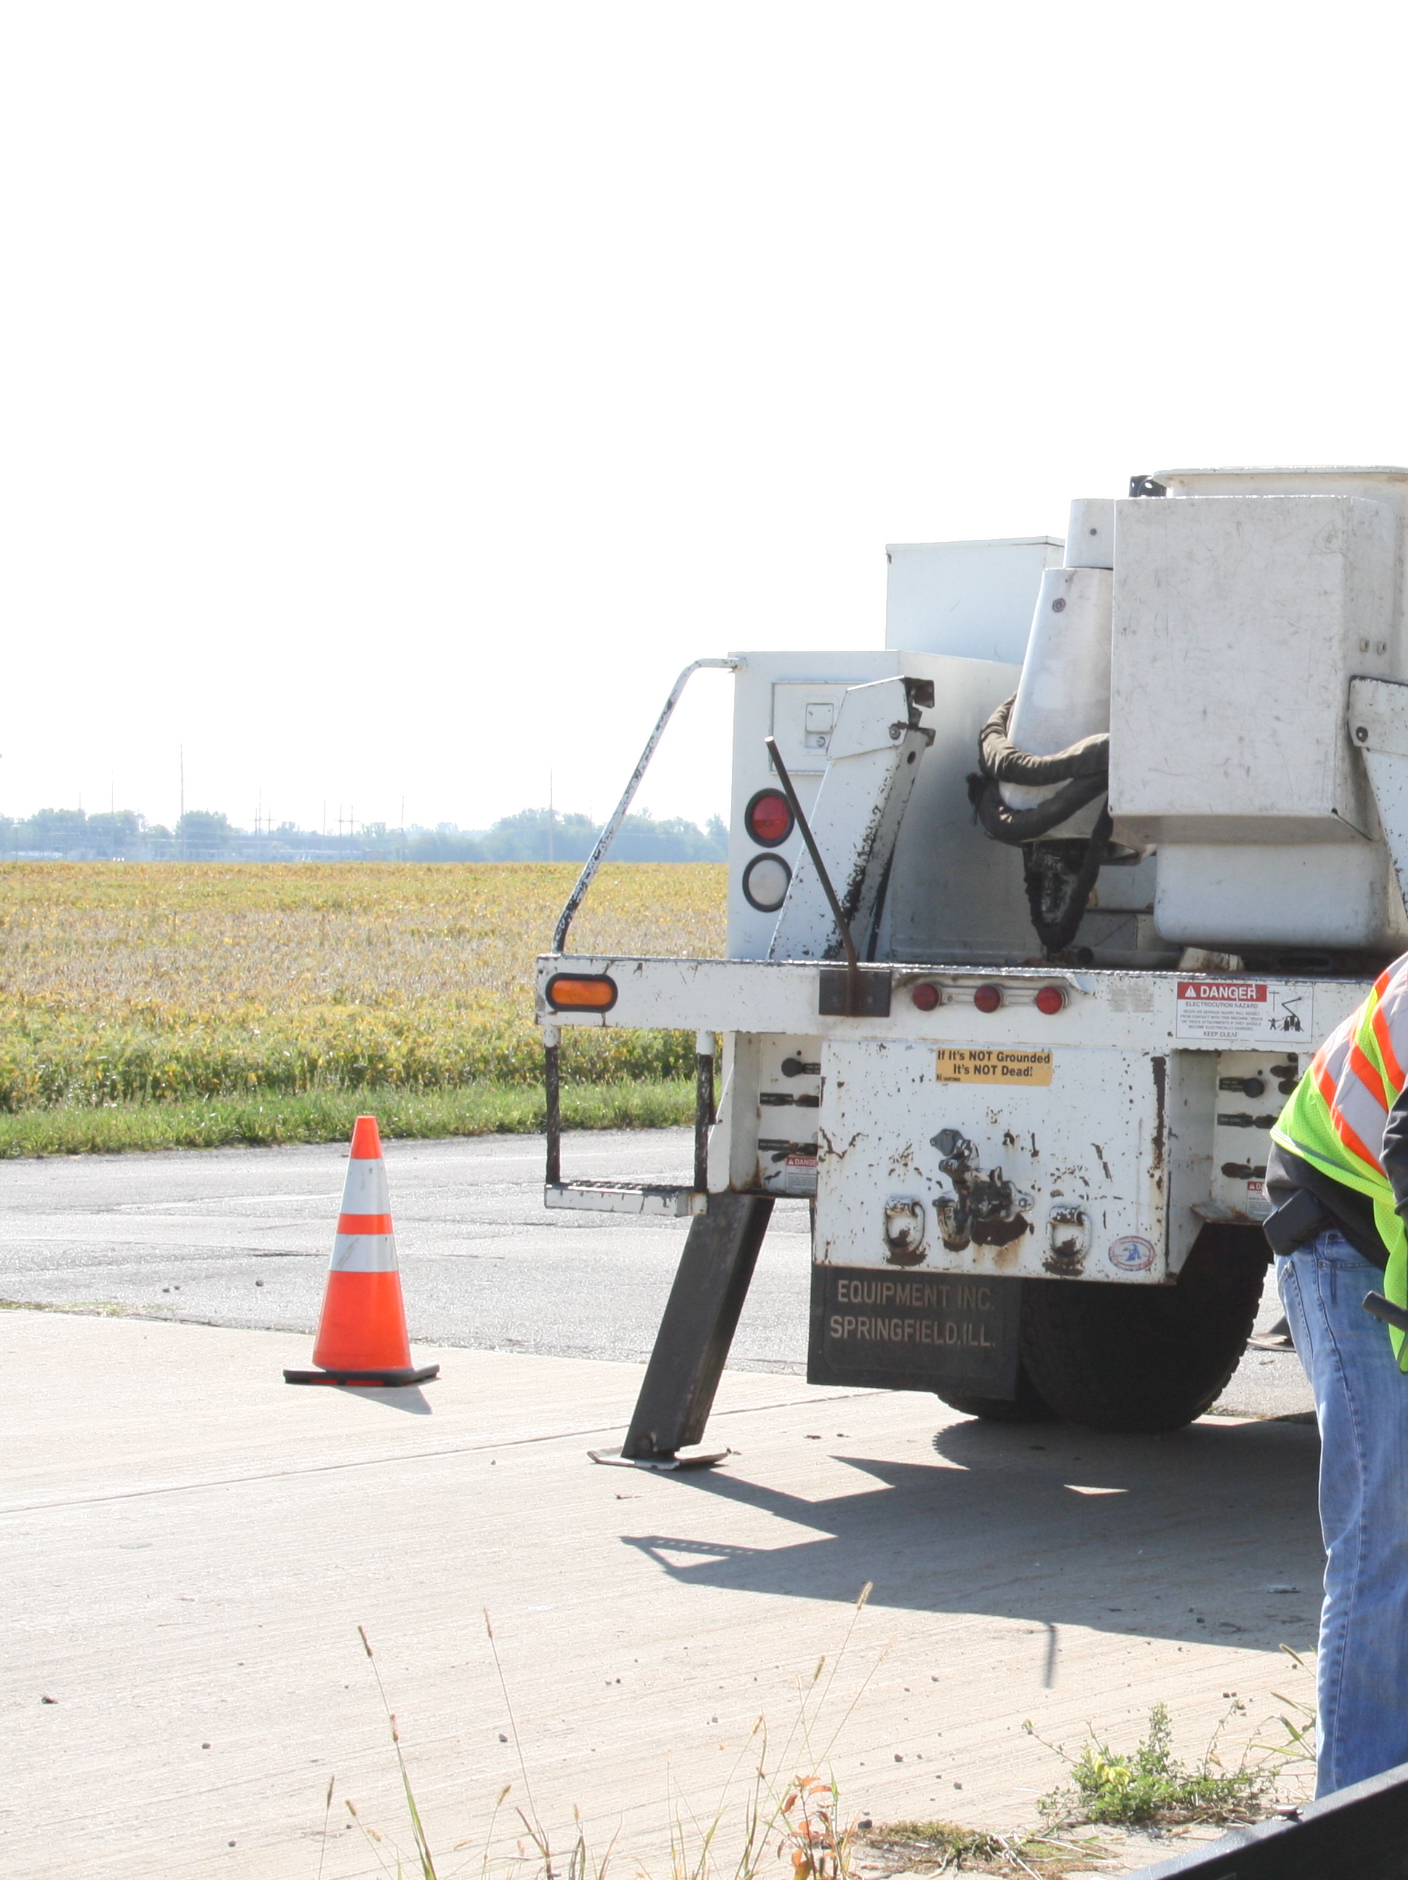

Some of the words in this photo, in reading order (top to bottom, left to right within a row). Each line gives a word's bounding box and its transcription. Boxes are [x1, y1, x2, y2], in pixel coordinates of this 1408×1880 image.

[1200, 985, 1257, 1000] DANGER
[937, 1050, 945, 1060] If
[948, 1050, 965, 1061] It's
[969, 1051, 993, 1062] NOT
[996, 1052, 1050, 1064] Grounded
[953, 1064, 970, 1075] It's
[973, 1065, 998, 1076] NOT
[1001, 1066, 1033, 1077] Dead!
[794, 1158, 818, 1168] DANGE
[837, 1279, 949, 1308] EQUIPMENT
[957, 1287, 995, 1311] INC.
